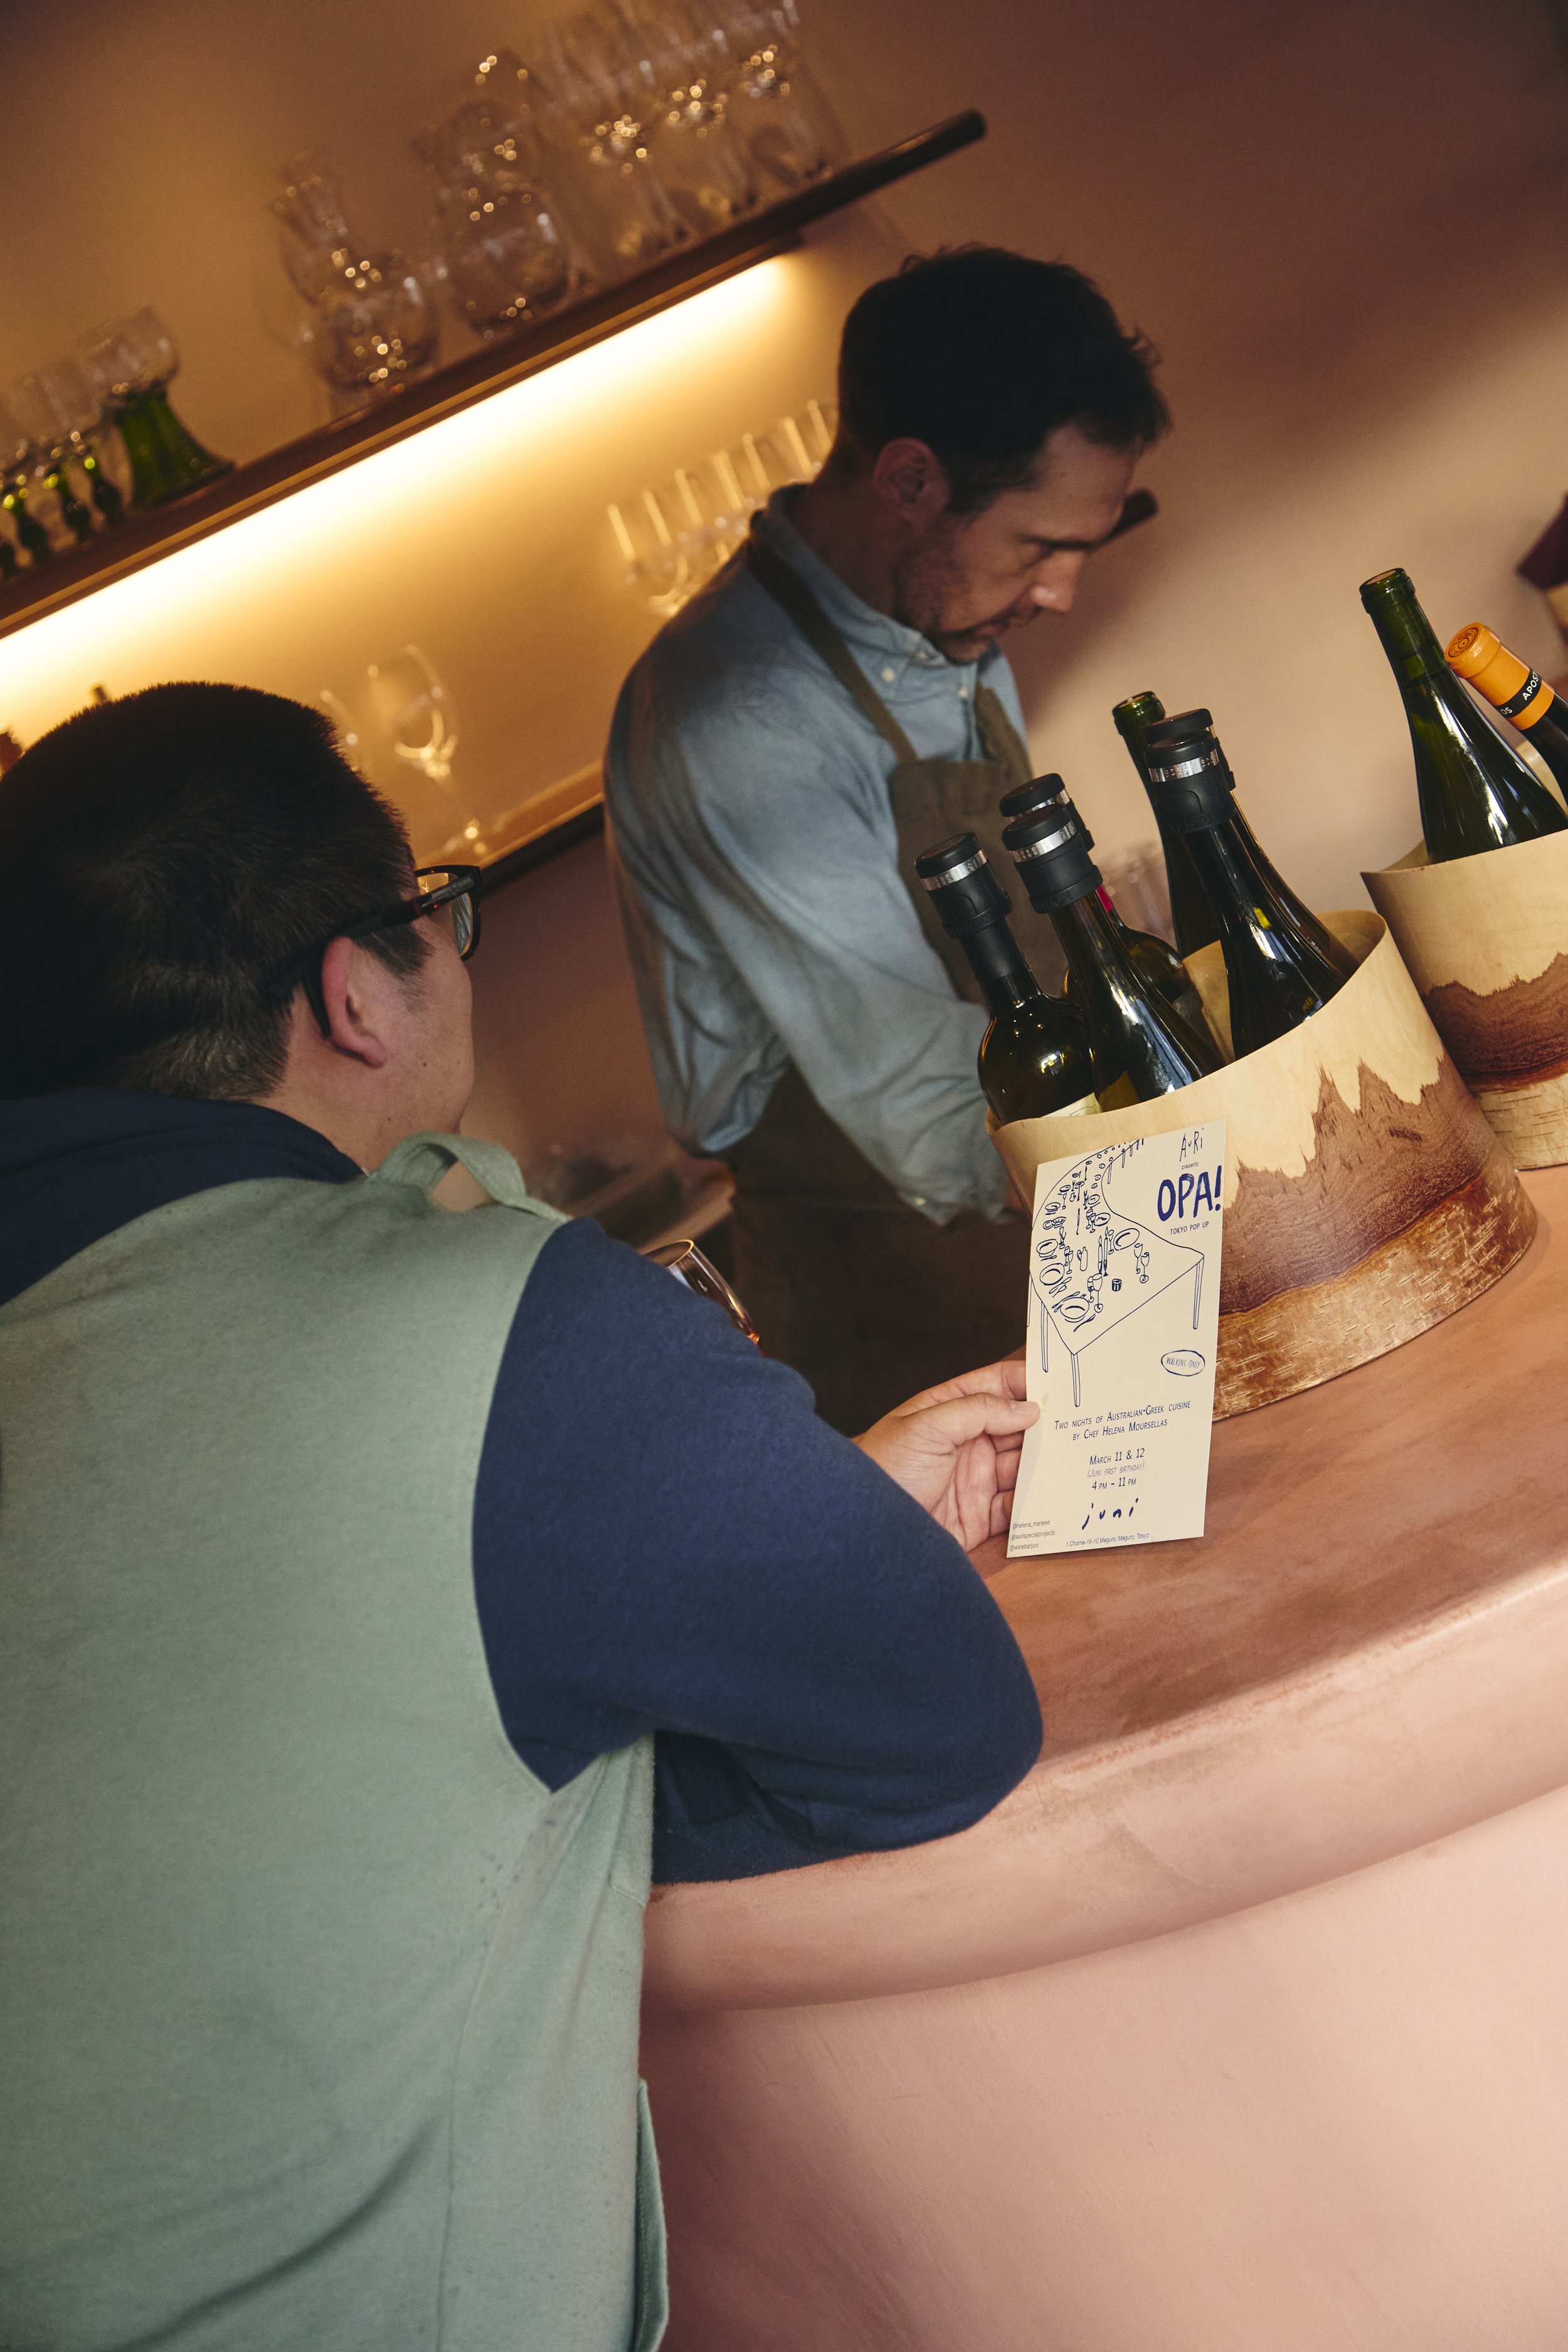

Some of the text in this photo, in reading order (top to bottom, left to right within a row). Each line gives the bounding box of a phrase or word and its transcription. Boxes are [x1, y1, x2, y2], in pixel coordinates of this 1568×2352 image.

[1182, 1162, 1199, 1170] presents
[1157, 1165, 1222, 1221] OPA!
[1170, 1226, 1187, 1235] TOKYO
[1189, 1359, 1201, 1369] ONLY
[1115, 1451, 1122, 1461] 11
[1126, 1449, 1132, 1460] &
[1136, 1448, 1145, 1458] 12
[1092, 1481, 1097, 1490] 4
[1118, 1476, 1125, 1487] 11
[1081, 1497, 1138, 1530] juni
